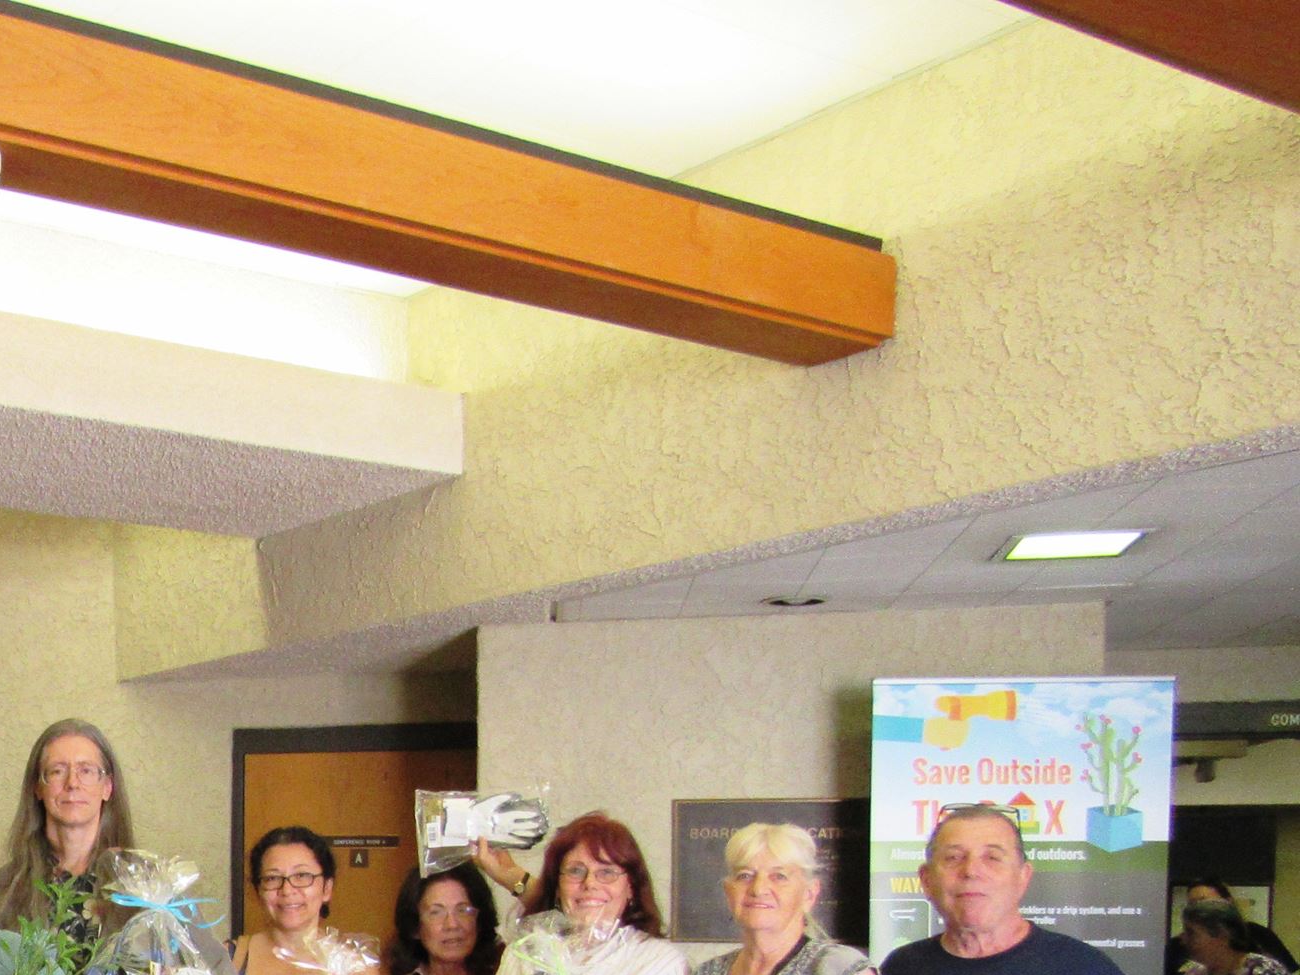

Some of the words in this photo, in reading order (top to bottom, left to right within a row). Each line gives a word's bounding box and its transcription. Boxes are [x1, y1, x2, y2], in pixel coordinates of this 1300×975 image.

[912, 757, 970, 785] Save
[977, 757, 1071, 785] Outside
[355, 853, 363, 864] A
[1037, 847, 1087, 860] outdoors.
